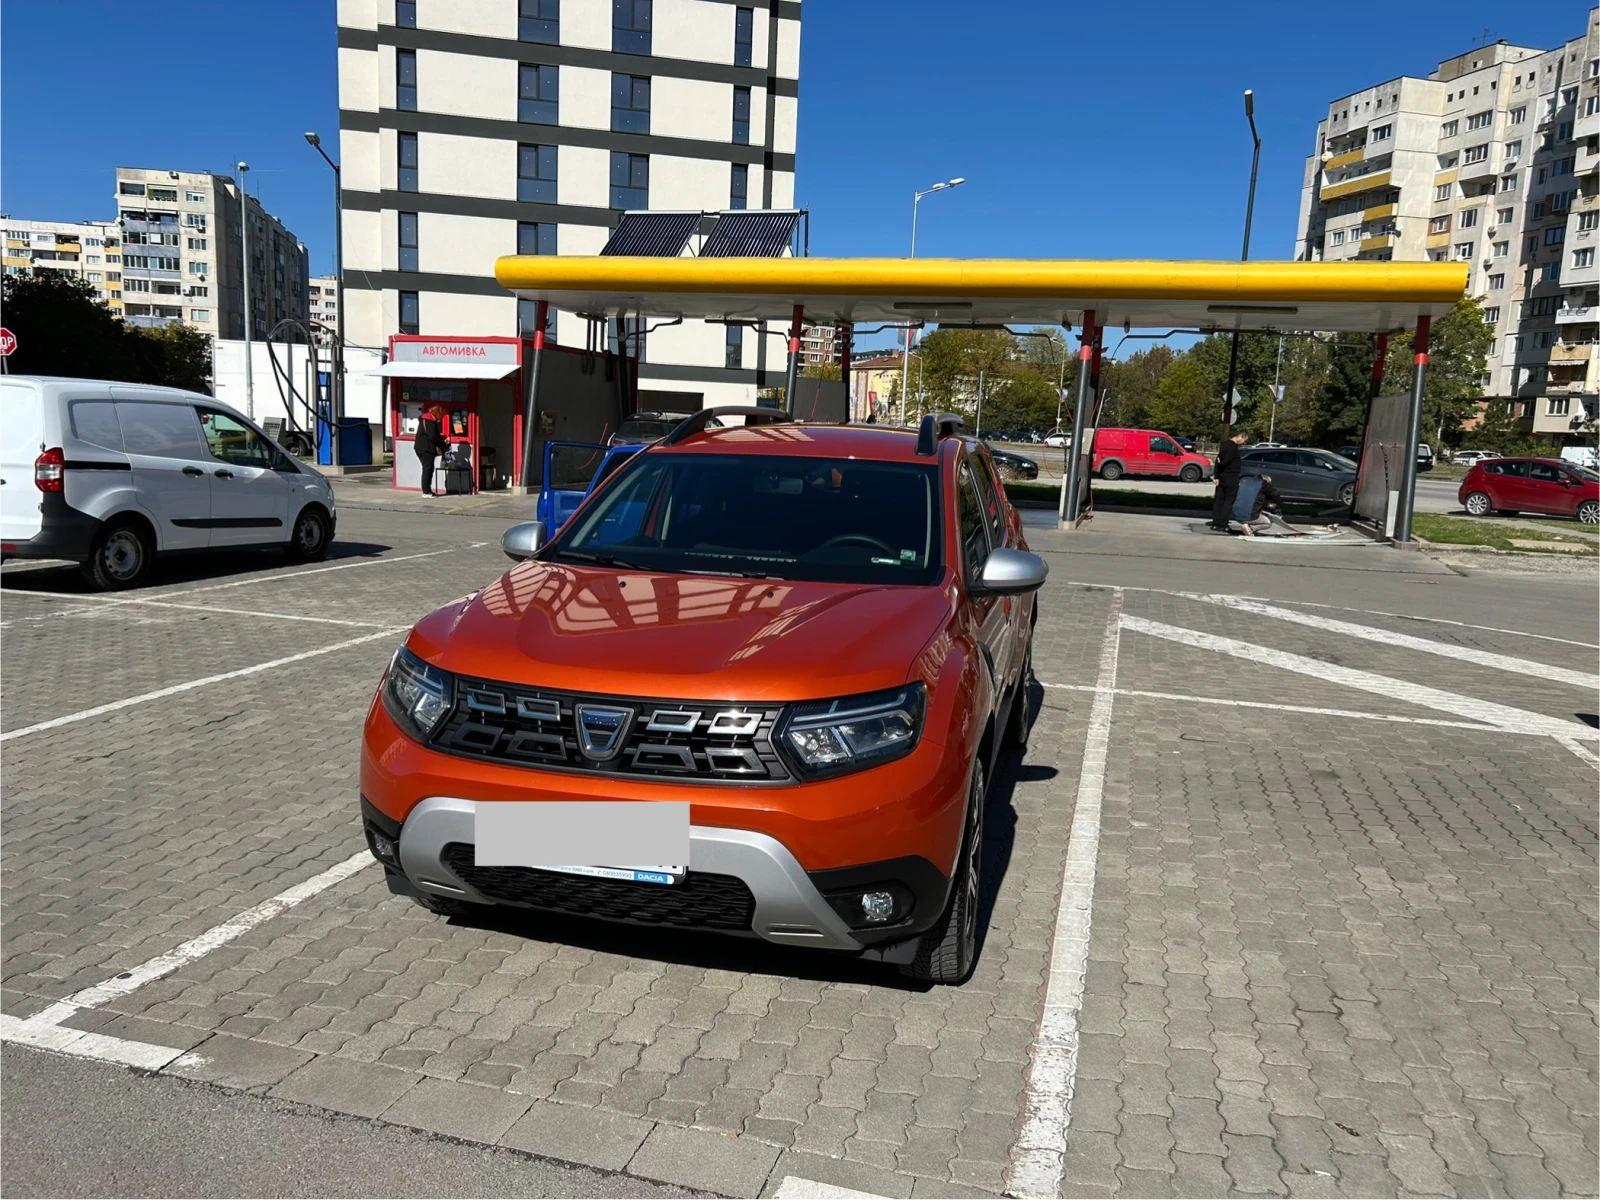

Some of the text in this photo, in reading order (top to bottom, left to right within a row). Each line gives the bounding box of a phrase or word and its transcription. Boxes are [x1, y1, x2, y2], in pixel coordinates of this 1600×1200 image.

[0, 336, 14, 348] OP
[422, 346, 487, 356] АВТОМИВКА
[637, 873, 664, 882] DACIA
